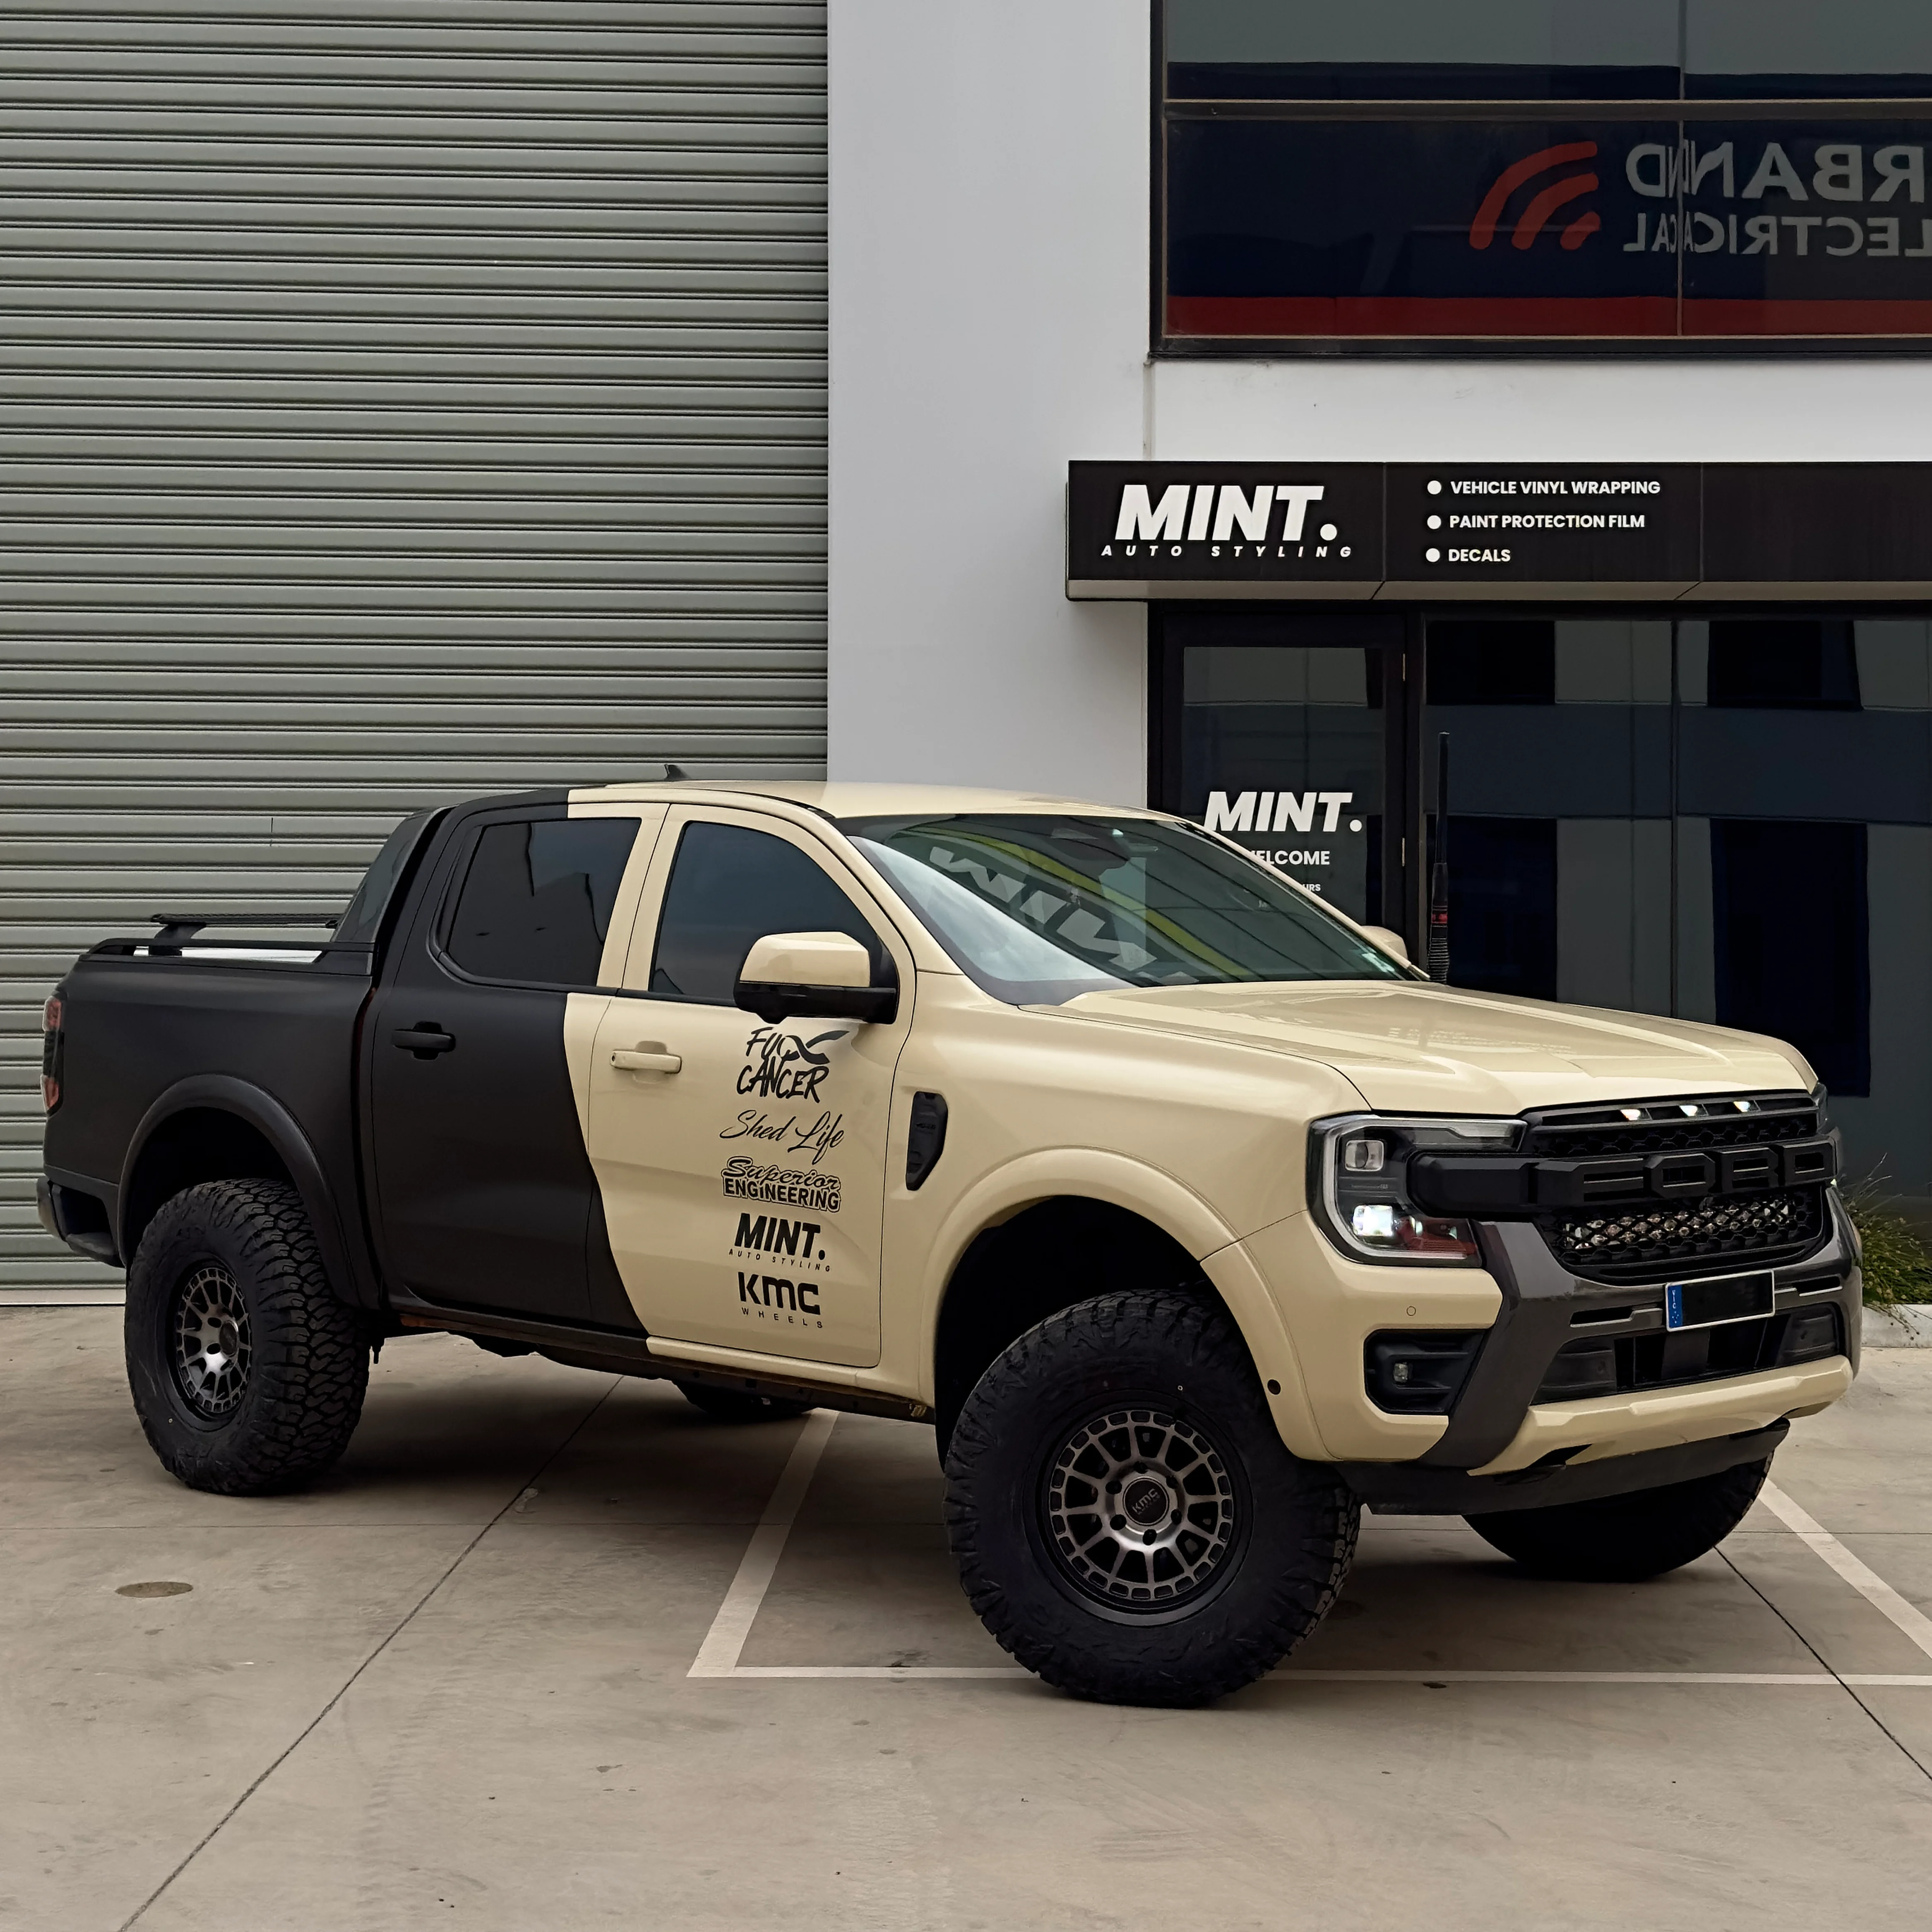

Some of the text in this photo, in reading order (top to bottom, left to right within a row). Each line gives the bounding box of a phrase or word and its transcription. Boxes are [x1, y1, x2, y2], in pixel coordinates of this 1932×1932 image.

[1450, 481, 1661, 494] VEHICLE VINYL WRAPPING
[1115, 484, 1338, 541] MINT.
[1450, 515, 1645, 528] PAINT PROTECTION FILM
[1101, 545, 1351, 557] AUTO STYLING
[1449, 549, 1511, 562] DECALS
[1204, 791, 1362, 832] MINT.
[1251, 850, 1330, 865] ELCOME
[736, 1056, 829, 1103] CANCER
[719, 1110, 844, 1165] Shed Life
[721, 1156, 841, 1191] Superior
[1532, 1137, 1835, 1206] FORD
[723, 1177, 841, 1212] ENGINEERING
[734, 1212, 826, 1260] MINT.
[728, 1248, 831, 1272] AUTO STYLING
[741, 1307, 823, 1329] WHEELS
